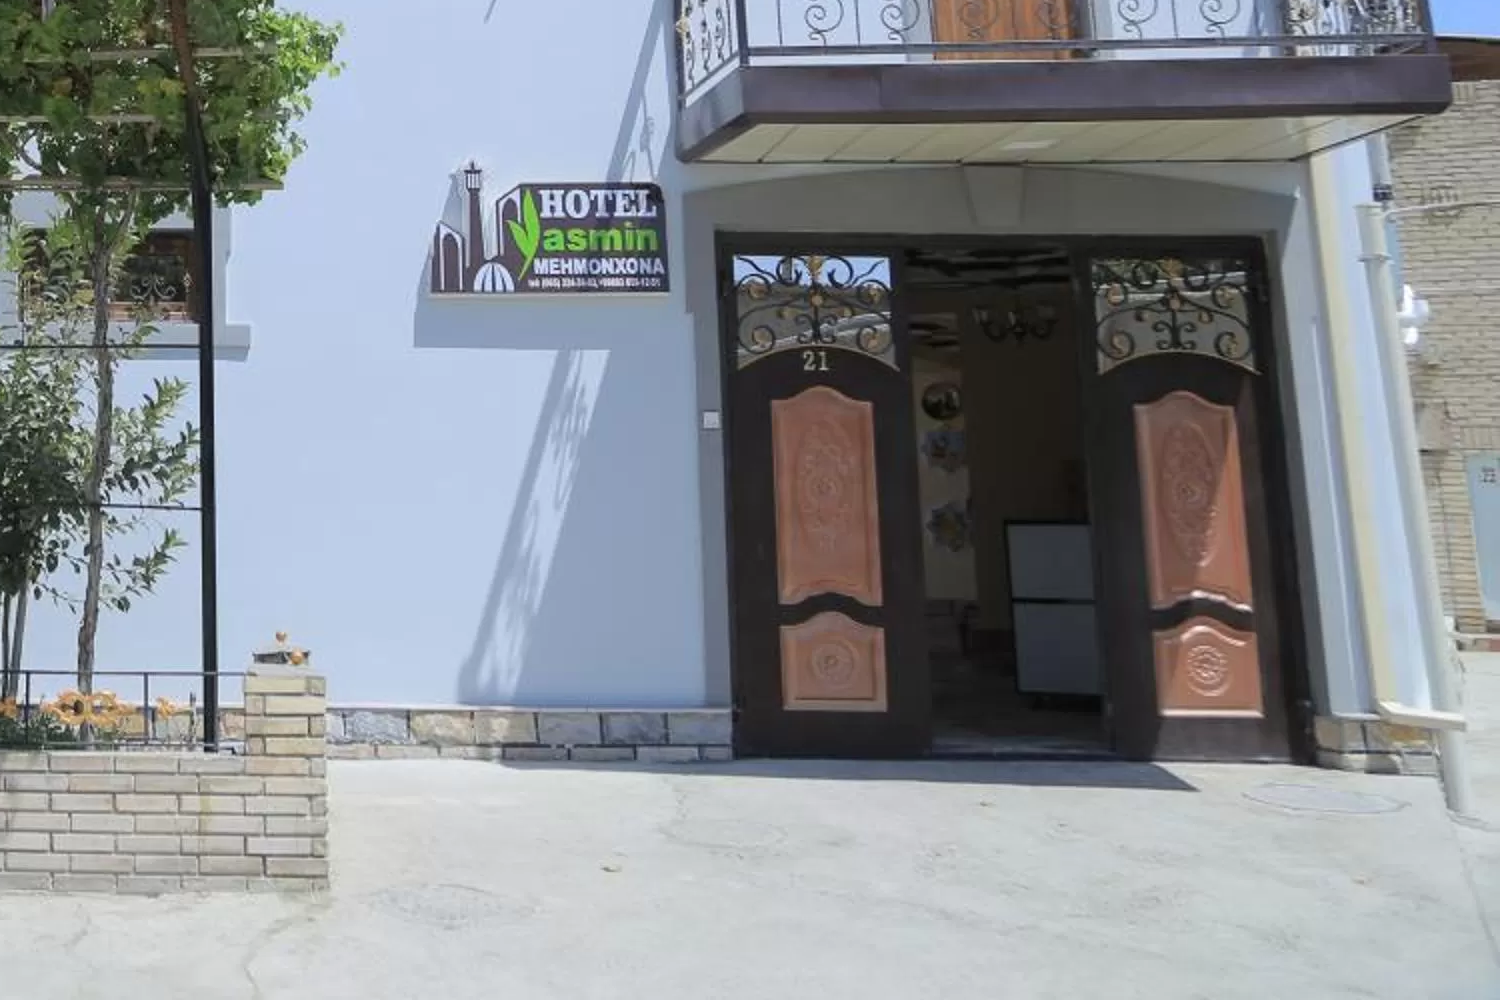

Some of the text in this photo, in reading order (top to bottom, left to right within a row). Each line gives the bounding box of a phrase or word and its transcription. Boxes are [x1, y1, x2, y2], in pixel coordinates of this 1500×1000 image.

[539, 189, 657, 219] HOTEL
[533, 257, 665, 275] MEHMONXONA
[803, 350, 829, 371] 21
